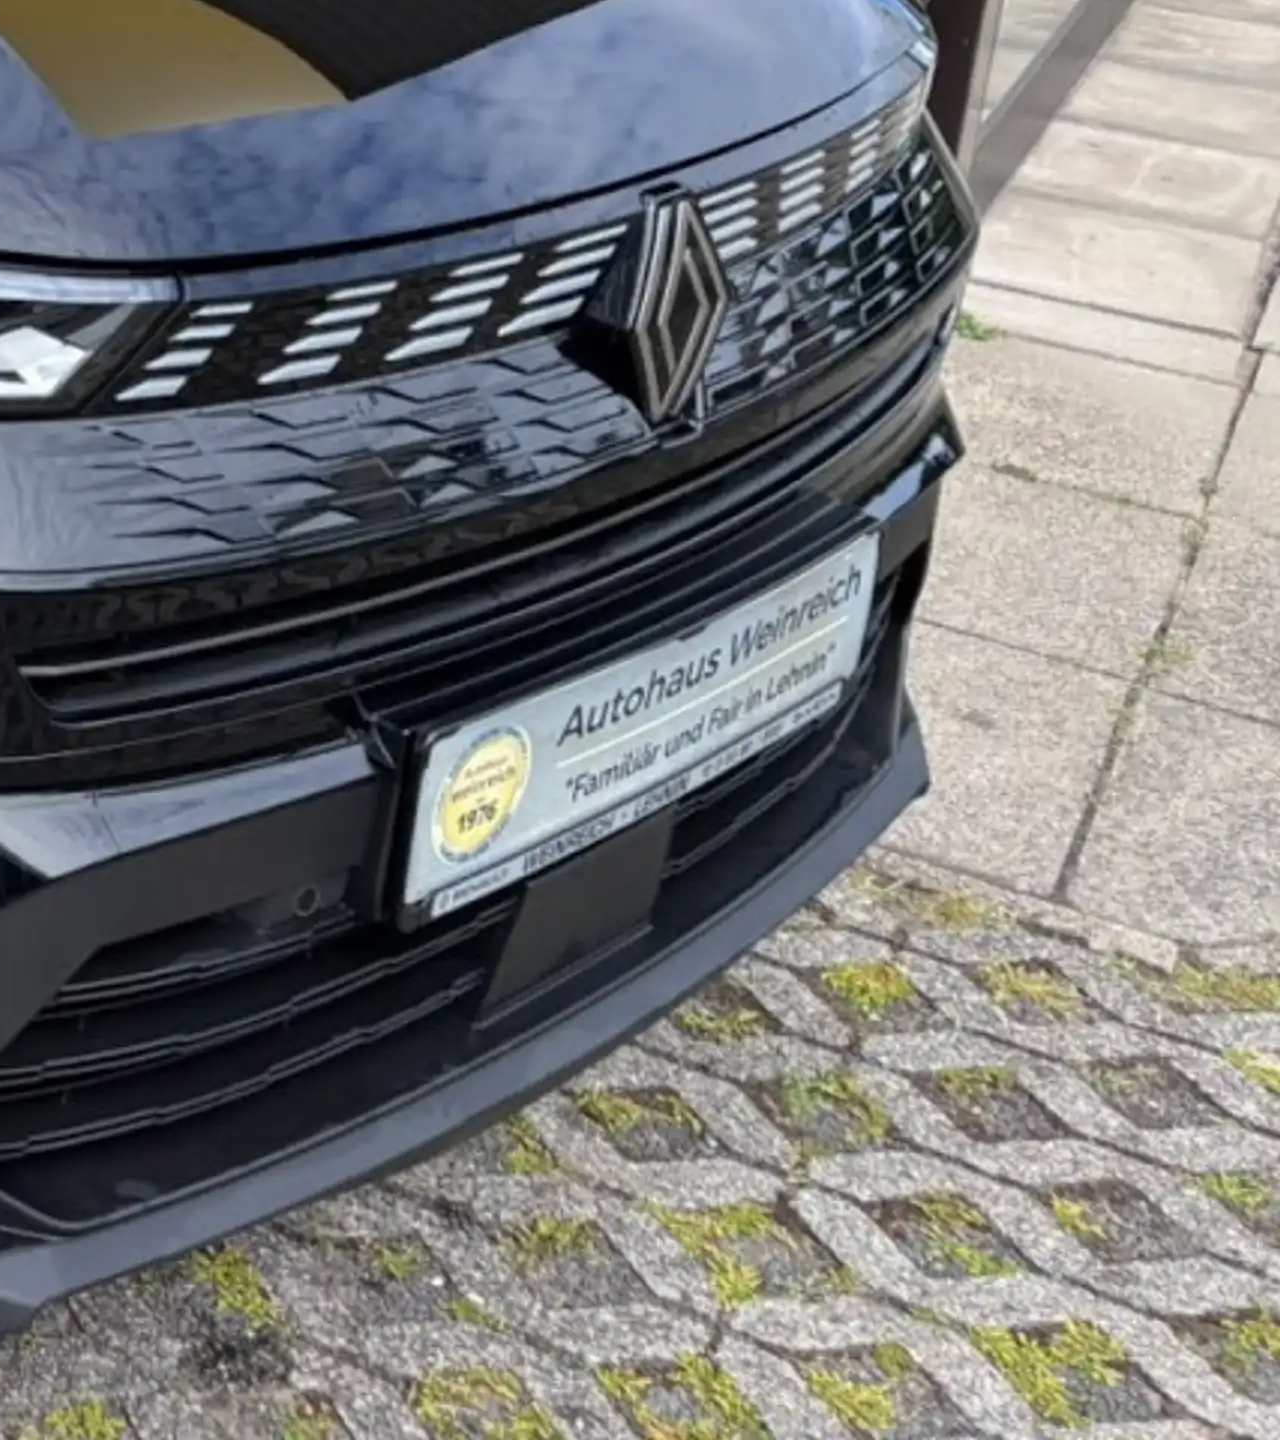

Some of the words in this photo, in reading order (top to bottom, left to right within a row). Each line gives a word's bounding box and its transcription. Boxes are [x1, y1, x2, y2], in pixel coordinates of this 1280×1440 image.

[556, 644, 723, 748] Autohaus
[728, 563, 863, 667] Weinreich
[662, 713, 706, 759] und
[706, 697, 744, 738] Fair
[743, 682, 763, 714] in
[457, 796, 500, 835] 1976
